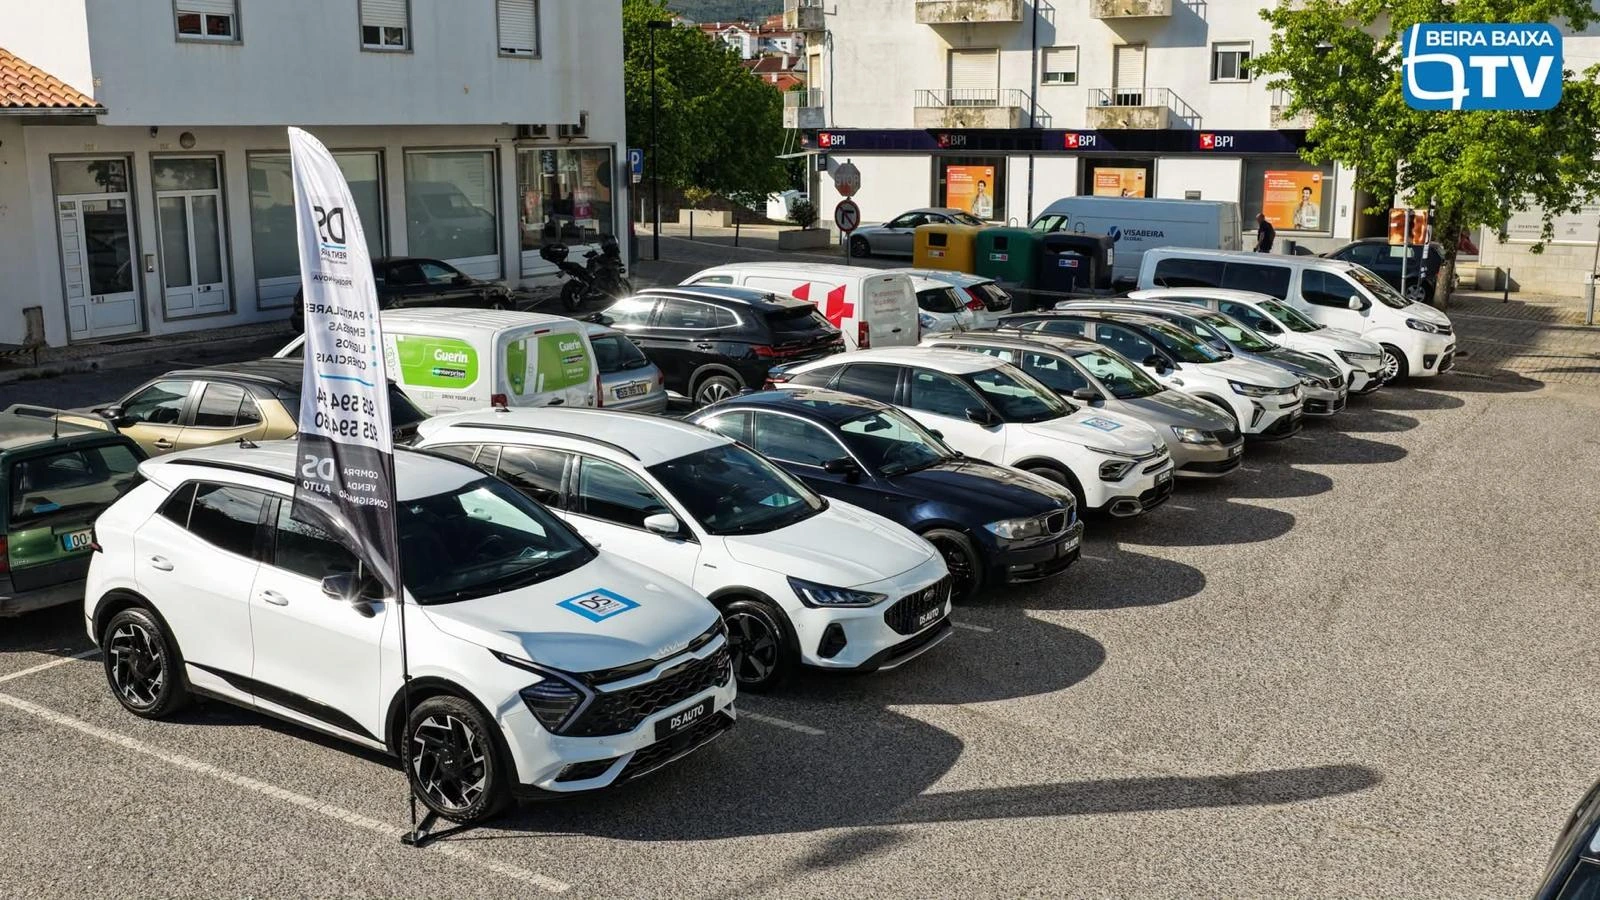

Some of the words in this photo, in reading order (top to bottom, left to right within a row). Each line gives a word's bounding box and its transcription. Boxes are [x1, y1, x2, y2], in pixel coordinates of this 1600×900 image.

[830, 134, 846, 146] BPI
[950, 134, 967, 146] BPI
[1078, 135, 1096, 147] BPI
[1214, 135, 1233, 148] BPI
[836, 173, 859, 186] STOP
[1123, 229, 1164, 238] VISABEIRA
[434, 349, 468, 363] Guerin
[578, 595, 612, 609] DS
[926, 607, 939, 621] AUTO
[671, 715, 681, 729] DS
[682, 704, 704, 724] AUTO
